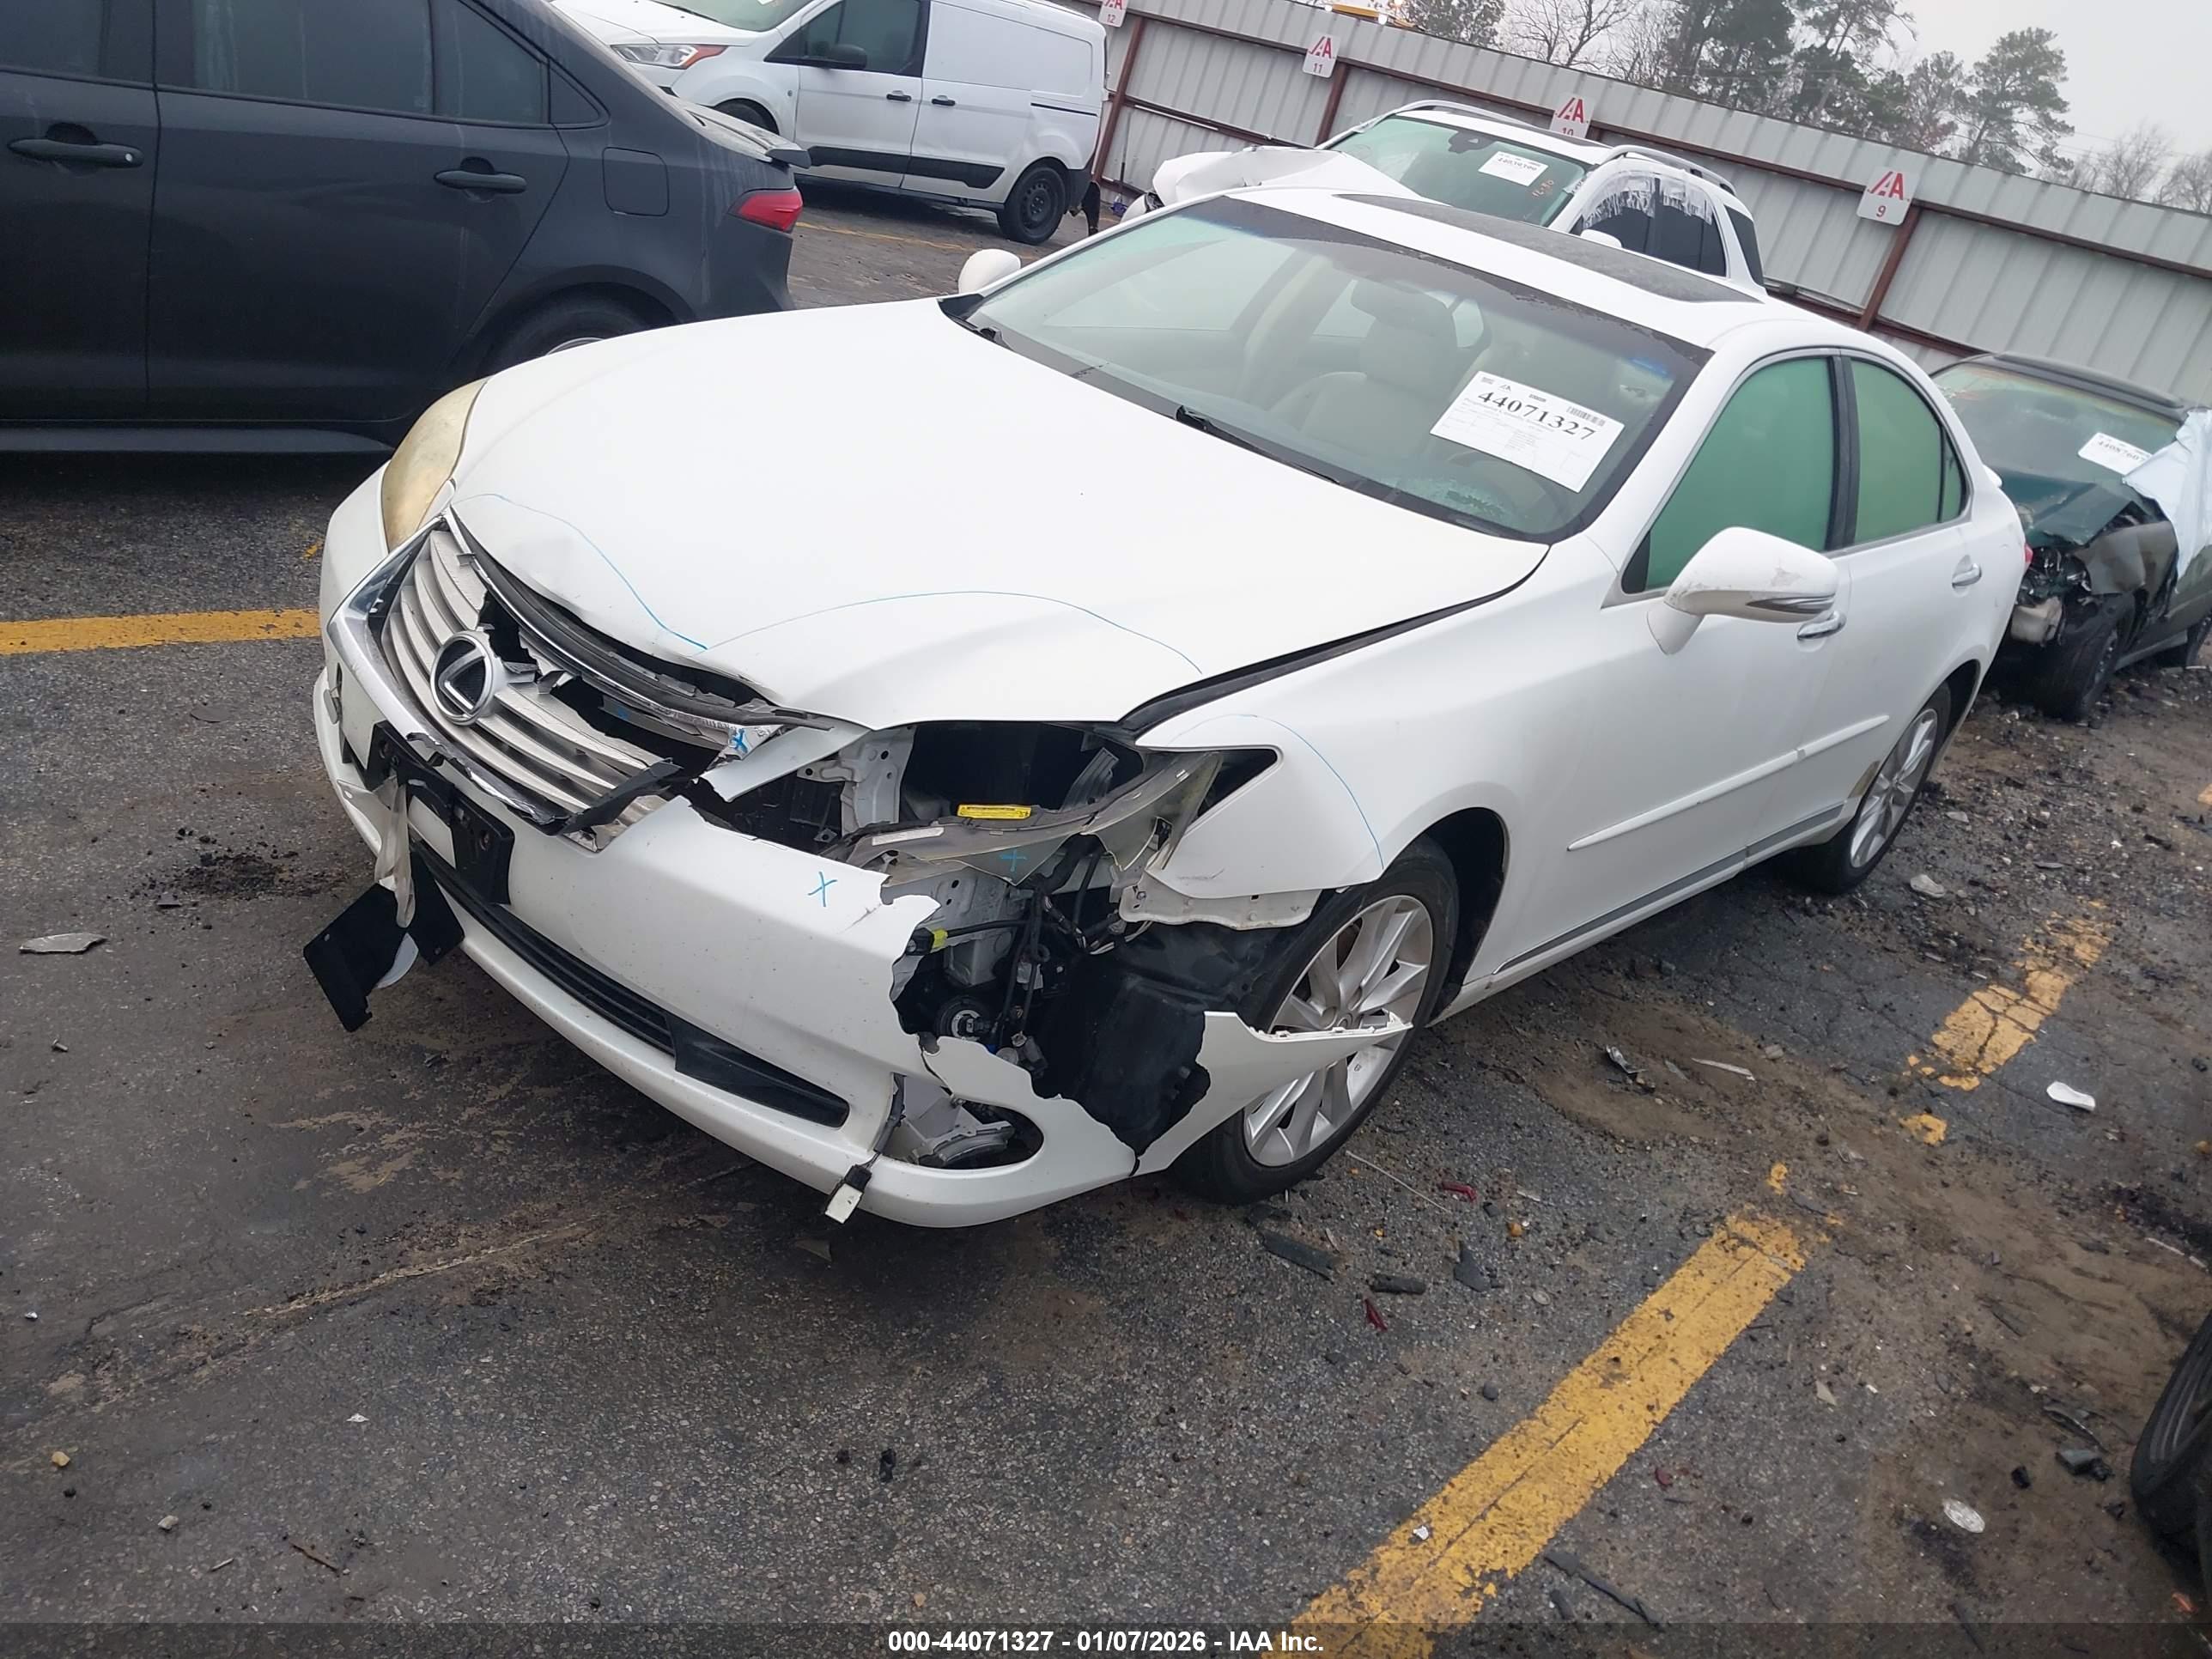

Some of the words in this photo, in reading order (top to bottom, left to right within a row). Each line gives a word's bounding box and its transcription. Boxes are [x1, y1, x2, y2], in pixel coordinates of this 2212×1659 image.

[1107, 13, 1116, 24] 12
[1313, 62, 1323, 74] 11
[1875, 204, 1887, 218] 9
[1477, 391, 1597, 441] 44071327
